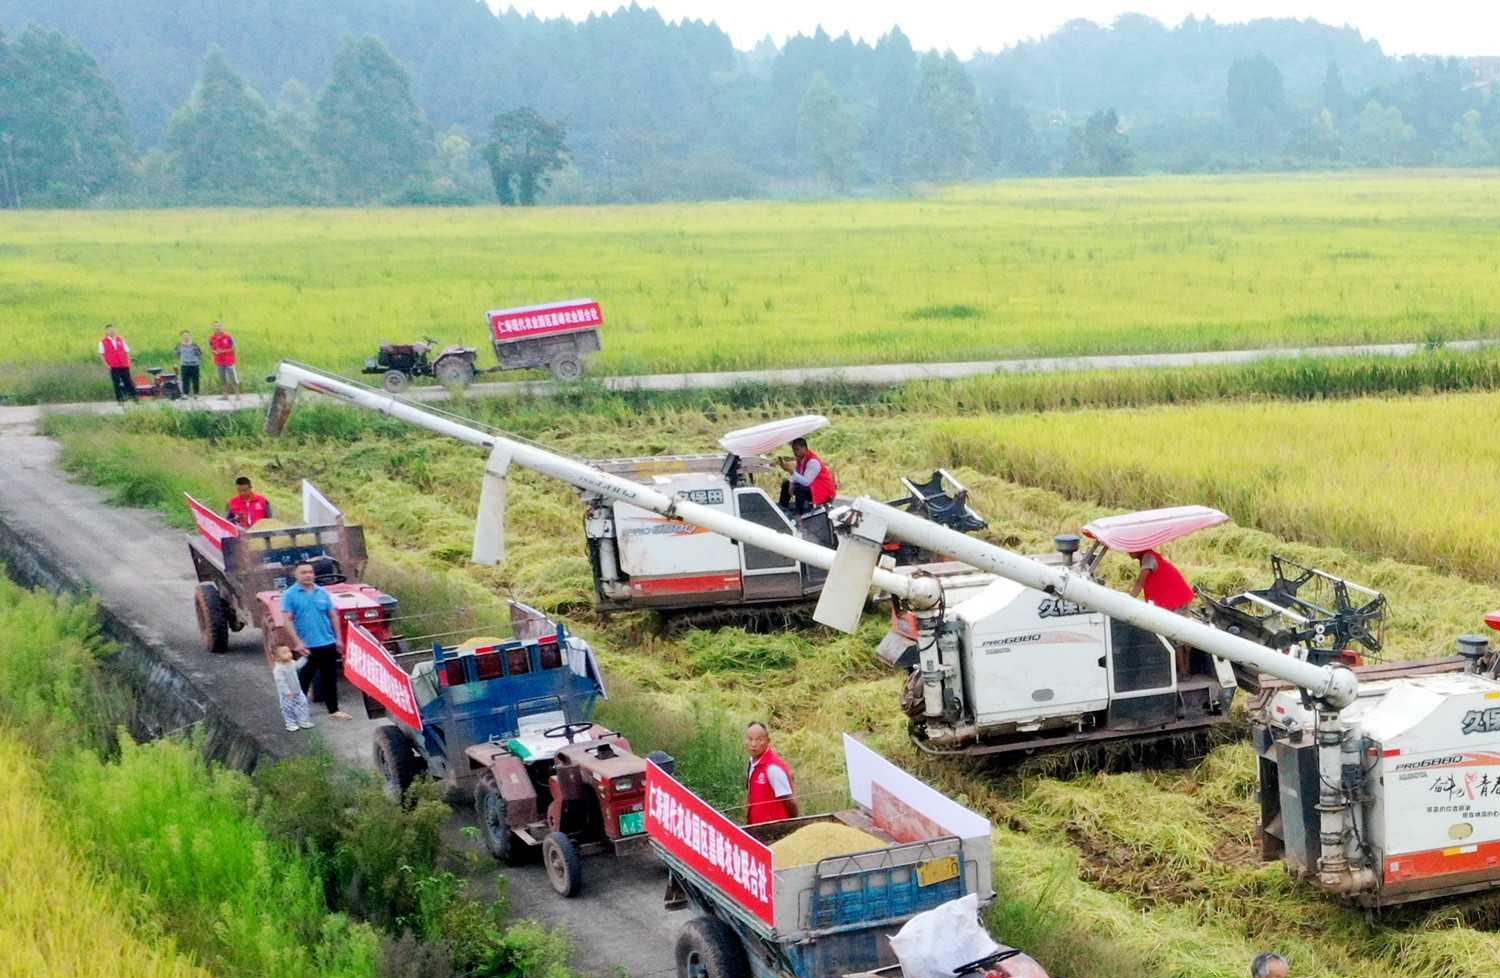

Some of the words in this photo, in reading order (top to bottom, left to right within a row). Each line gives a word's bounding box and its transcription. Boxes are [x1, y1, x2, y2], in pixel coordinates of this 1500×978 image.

[1037, 598, 1098, 619] 久保
[649, 780, 769, 903] 仁寿现代农业园区嘉峰农业联合社
